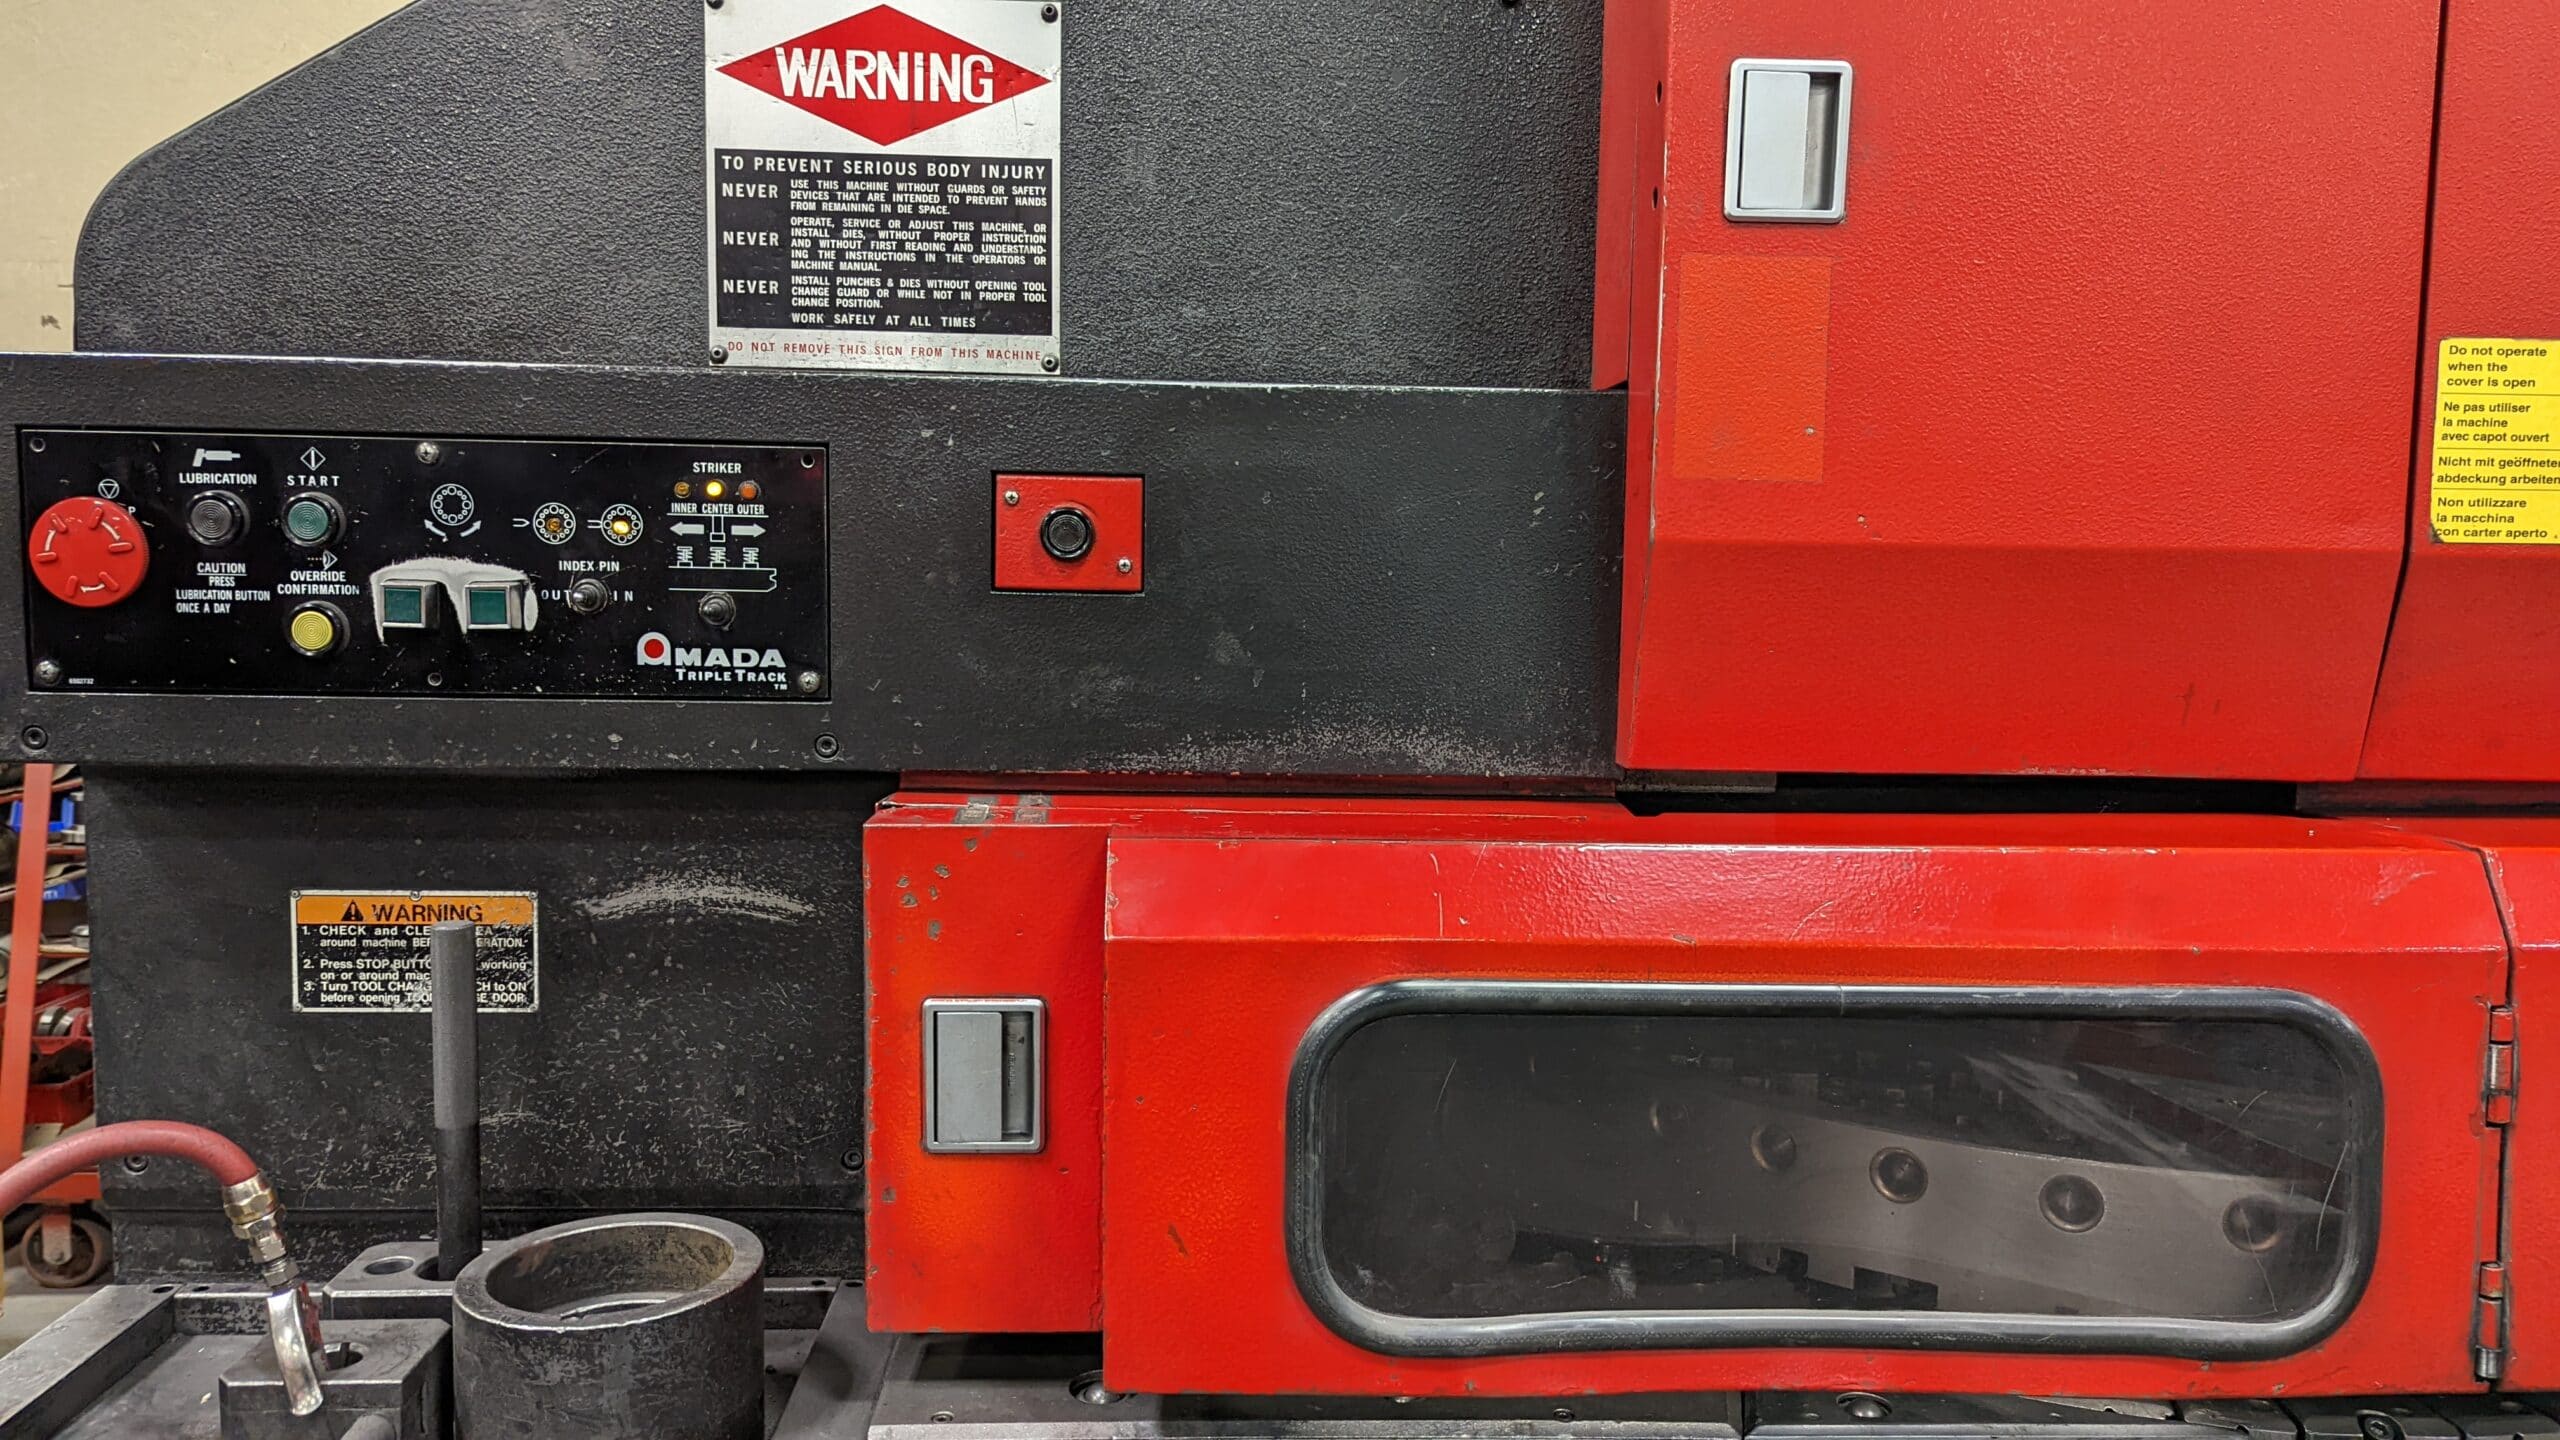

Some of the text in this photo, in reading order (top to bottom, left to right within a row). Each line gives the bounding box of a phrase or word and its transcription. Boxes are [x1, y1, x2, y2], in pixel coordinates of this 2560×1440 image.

[774, 47, 993, 104] WARNING
[721, 156, 1045, 180] TO PREVENT SERIOUS BODY INJURY
[721, 184, 778, 199] NEVER
[790, 180, 1047, 195] USE THIS MACHINE WITHOUT GUARDS OR SAFETY
[789, 190, 1047, 206] DEVICES THAT ARE INTENDED TO PREVENT HANDS
[790, 202, 950, 215] FROM REMAINING IN DIE SPACE.
[789, 217, 1047, 233] OPERATE, SERVICE OR ADJUST THIS MACHINE, OR
[722, 232, 779, 247] NEVER
[790, 228, 1046, 243] INSTALL DIES, WITHOUT PROPER INSTRUCTION
[790, 239, 1047, 254] AND WITHOUT FIRST READING AND UNDERSTAND-
[790, 250, 1046, 265] ING THE INSTRUCTIONS IN THE OPERATORS OR
[790, 261, 882, 272] MACHINE MANUAL.
[722, 280, 778, 294] NEVER
[791, 276, 1047, 291] INSTALL PUNCHES & DIES WITHOUT OPENING TOOL
[790, 287, 1047, 302] CHANGE GUARD OR WHILE NOT IN PROPER TOOL
[791, 298, 883, 309] CHANGE POSITION.
[791, 313, 976, 327] WORK SAFELY AT ALL TIMES
[728, 342, 1041, 361] DO NOT REMOVE THIS SIGN FROM THIS MACHINE
[2448, 345, 2547, 356] Do not operate
[2447, 363, 2508, 372] when the
[2446, 377, 2536, 387] cover is open
[2443, 402, 2531, 412] Ne pas utiliser
[2442, 417, 2508, 427] la machine
[2440, 432, 2549, 442] avec capot ouvert
[2437, 457, 2495, 467] Nicht mit
[692, 462, 742, 474] STRIKER
[178, 473, 257, 484] LUBRICATION
[286, 475, 340, 486] START
[2436, 474, 2507, 483] abdeckung
[2437, 497, 2527, 507] Non utilizzare
[670, 502, 765, 514] INNER CENTER OUTER
[2435, 513, 2515, 523] la macchina
[2433, 528, 2548, 537] con carter aperto
[196, 562, 246, 573] CAUTION
[558, 560, 620, 572] INDEX PIN
[208, 576, 236, 586] PRESS
[289, 570, 346, 581] OVERRIDE
[175, 589, 270, 601] LUBRICATION BUTTON
[276, 584, 360, 595] CONFIRMATION
[540, 590, 573, 600] OUT
[613, 591, 633, 601] IN
[175, 602, 231, 613] ONCE A DAY
[675, 669, 786, 683] TRIPLE TRACK
[371, 904, 483, 922] WARNING
[318, 926, 367, 935] CHECK
[373, 927, 398, 935] and
[319, 938, 357, 947] around
[361, 938, 407, 948] machine
[320, 959, 352, 969] Press
[356, 959, 390, 969] STOP
[481, 960, 527, 971] working
[320, 972, 335, 980] on
[339, 972, 353, 980] or
[358, 972, 399, 980] around
[321, 982, 348, 991] Turn
[352, 982, 385, 991] TOOL
[508, 982, 527, 992] ON
[320, 993, 355, 1003] before
[358, 994, 400, 1003] opening
